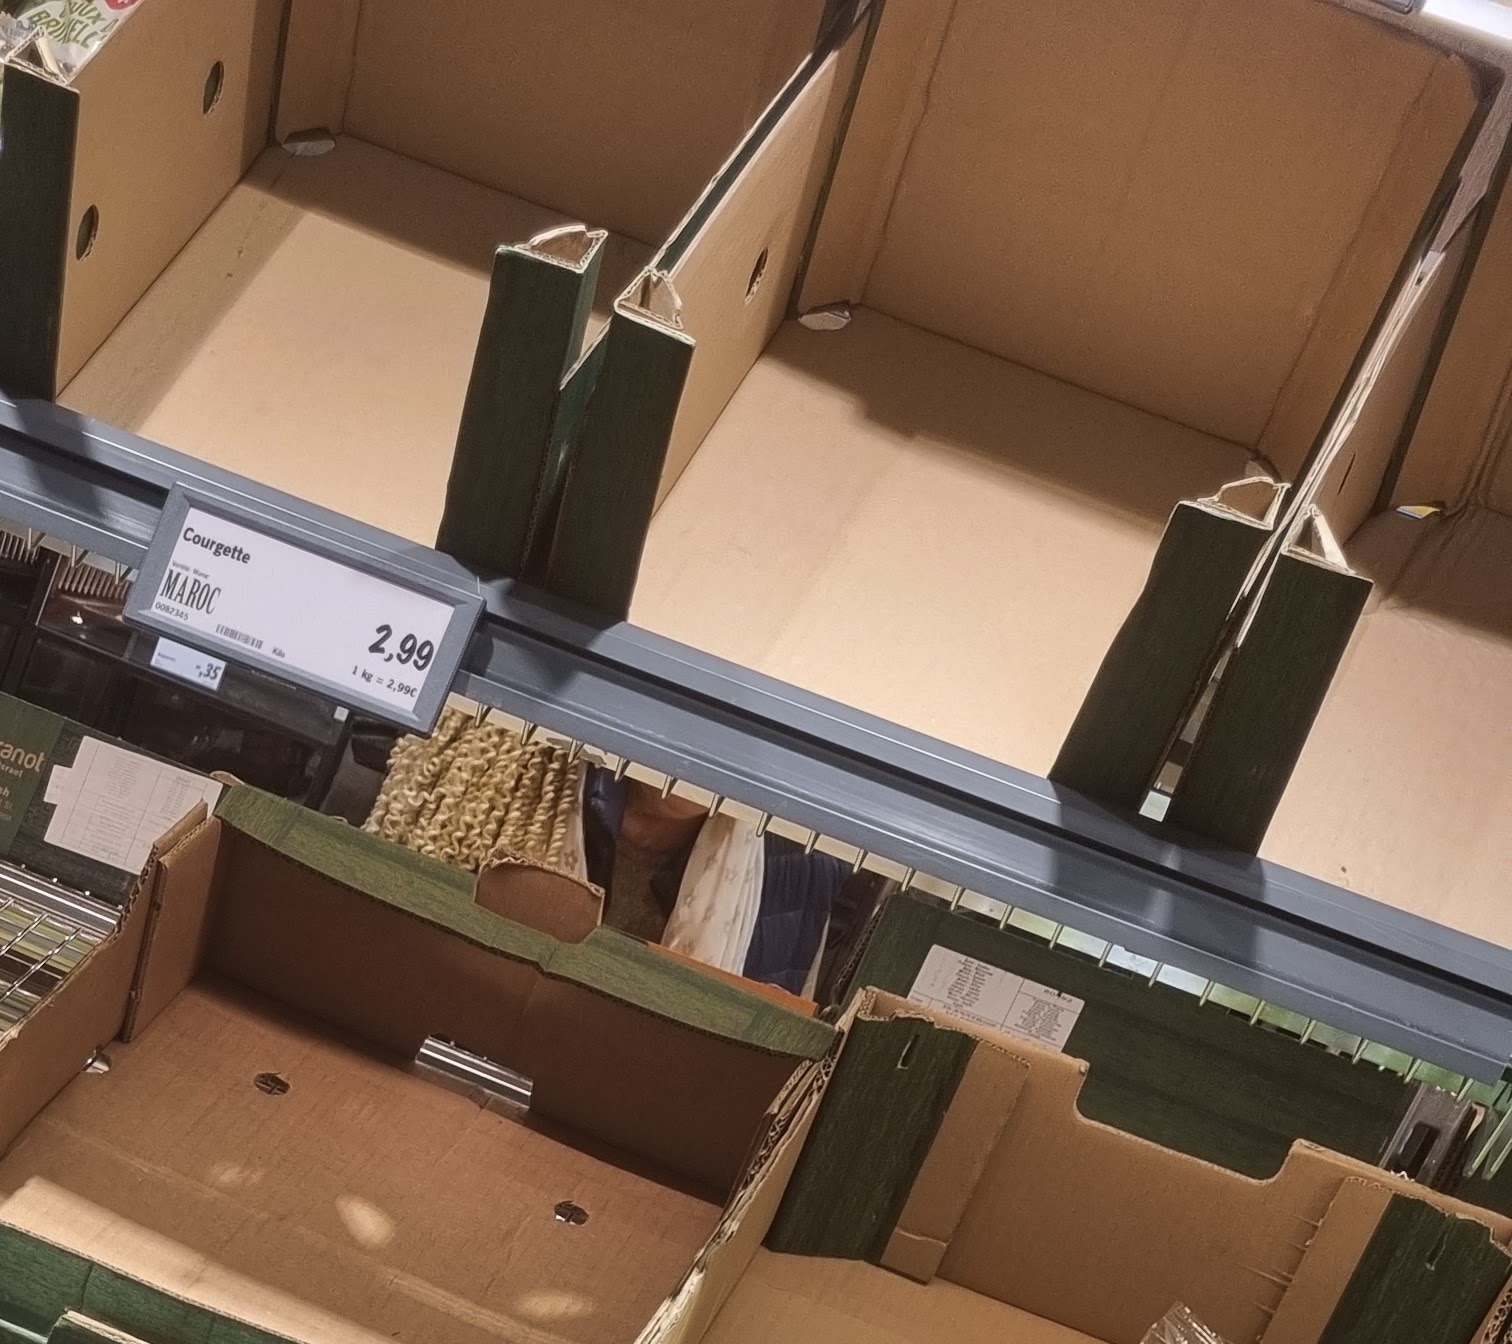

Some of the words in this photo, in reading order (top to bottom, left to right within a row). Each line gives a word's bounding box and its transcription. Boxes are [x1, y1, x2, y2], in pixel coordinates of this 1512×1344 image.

[181, 525, 252, 567] Courgette
[154, 601, 190, 621] 0082345
[159, 568, 222, 616] MAROC
[366, 620, 437, 676] 2,99
[351, 665, 359, 675] 1
[359, 668, 374, 683] kg
